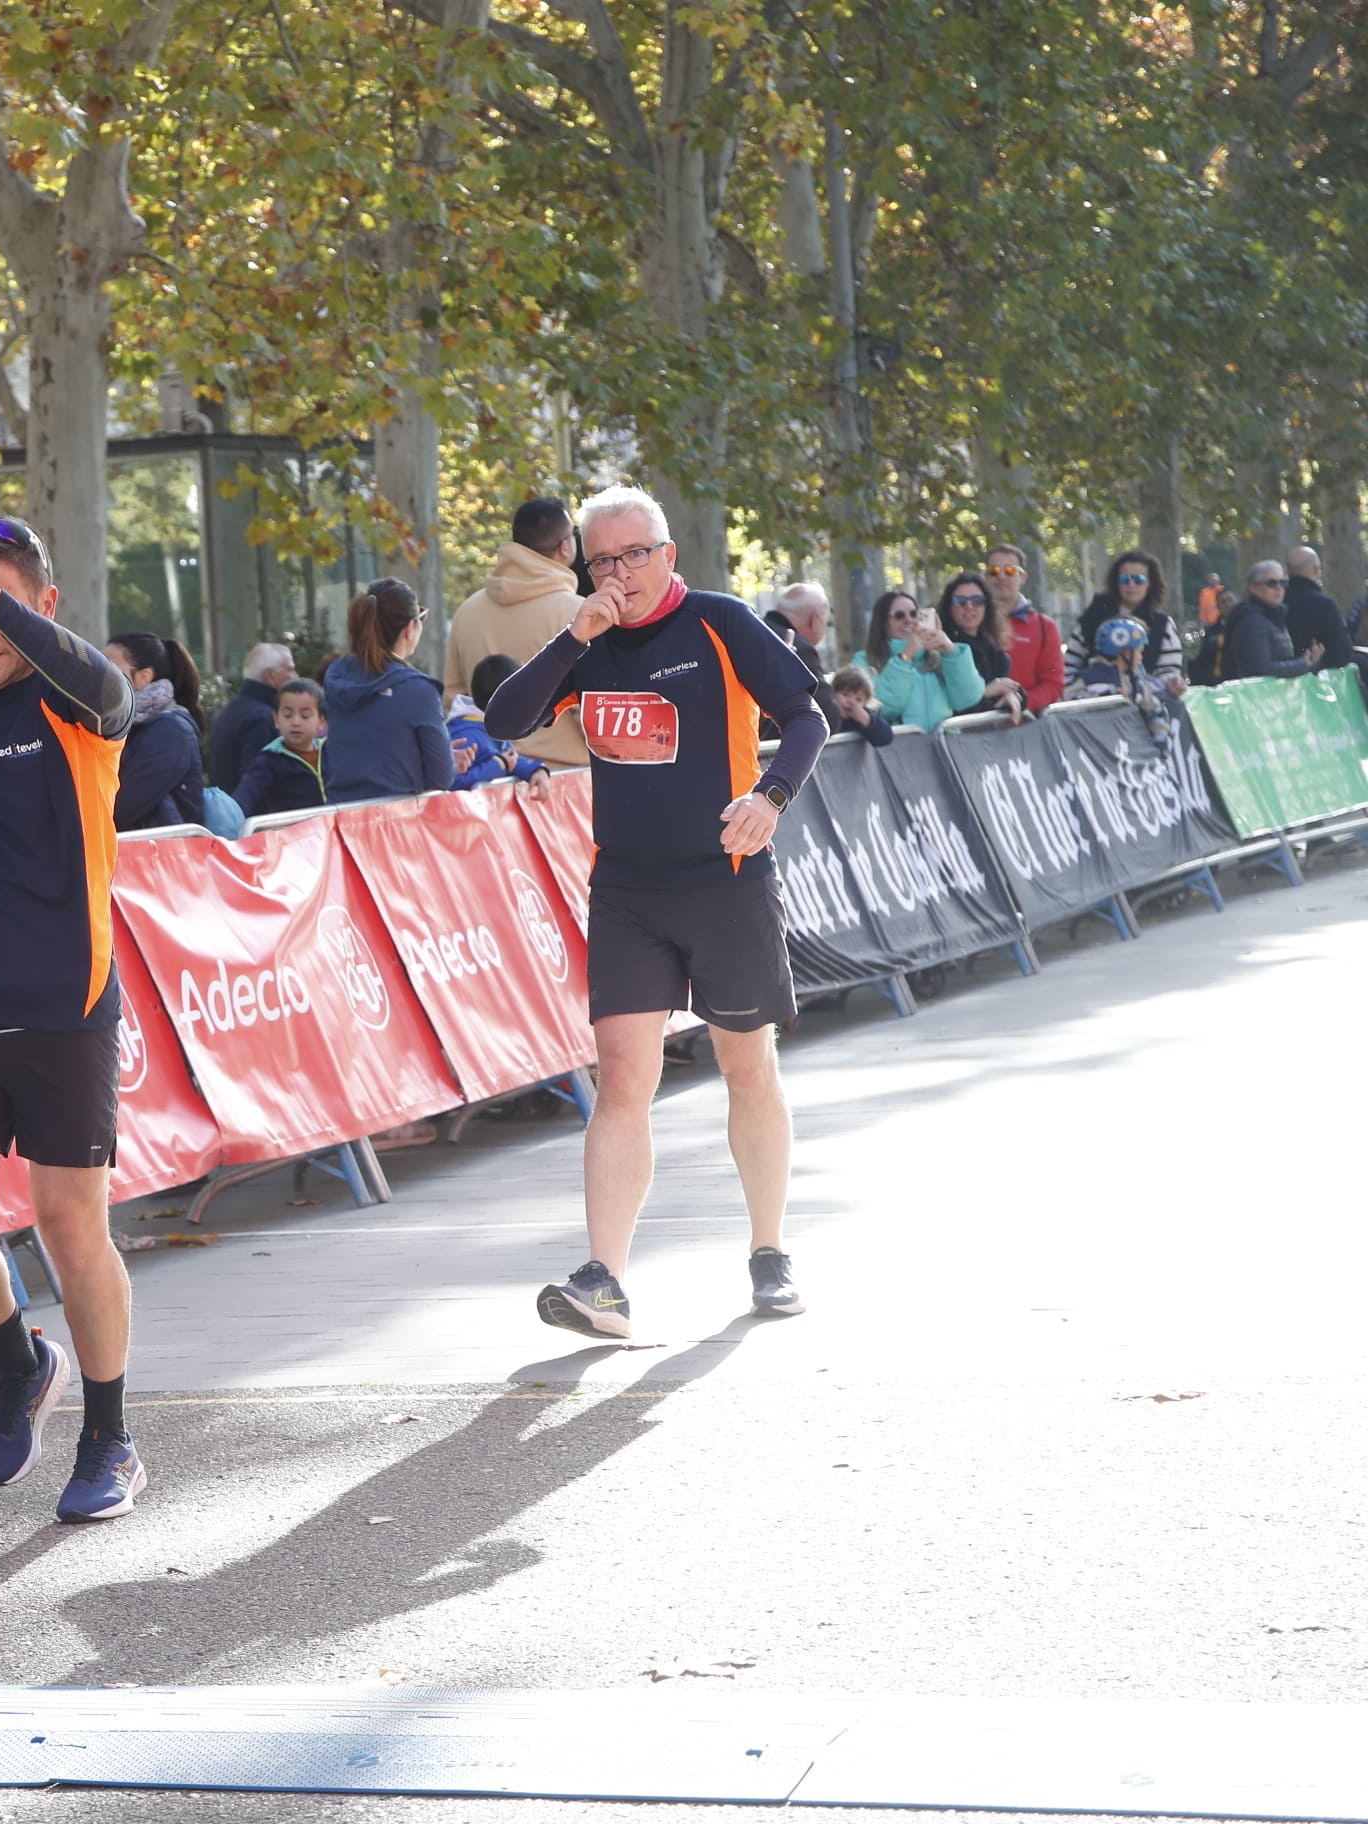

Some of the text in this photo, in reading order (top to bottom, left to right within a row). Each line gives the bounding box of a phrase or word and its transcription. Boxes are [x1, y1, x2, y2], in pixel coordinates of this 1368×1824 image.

[595, 707, 643, 737] 178
[402, 920, 502, 988] Adecco
[178, 958, 311, 1040] Adecco
